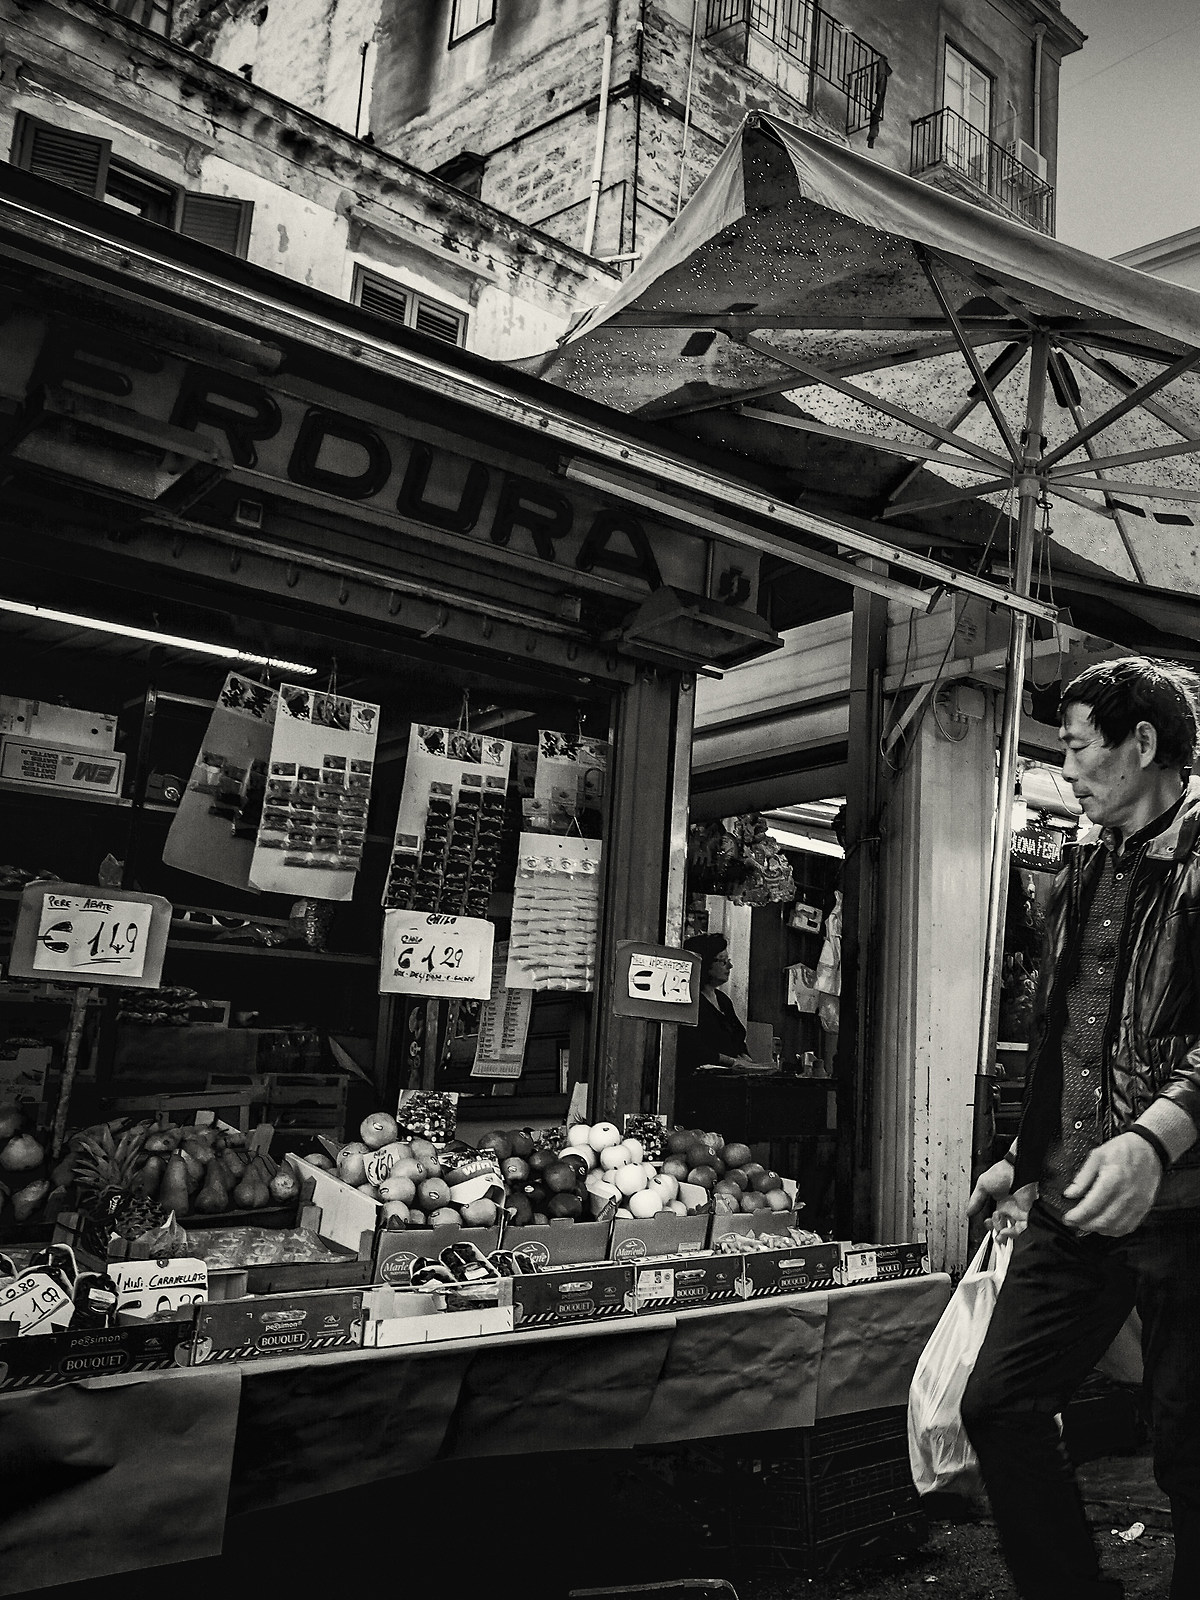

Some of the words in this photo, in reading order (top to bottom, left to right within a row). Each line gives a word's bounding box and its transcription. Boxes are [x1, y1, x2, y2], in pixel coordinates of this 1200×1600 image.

[72, 762, 116, 784] EM
[48, 896, 71, 908] PERE
[83, 898, 114, 912] ABATE
[37, 921, 73, 953] €
[88, 921, 138, 956] 1.49
[676, 1287, 705, 1300] BOUQUET
[558, 1302, 591, 1314] BOUQUET
[261, 1333, 305, 1347] BOUQUET
[66, 1354, 123, 1372] BOUQUET
